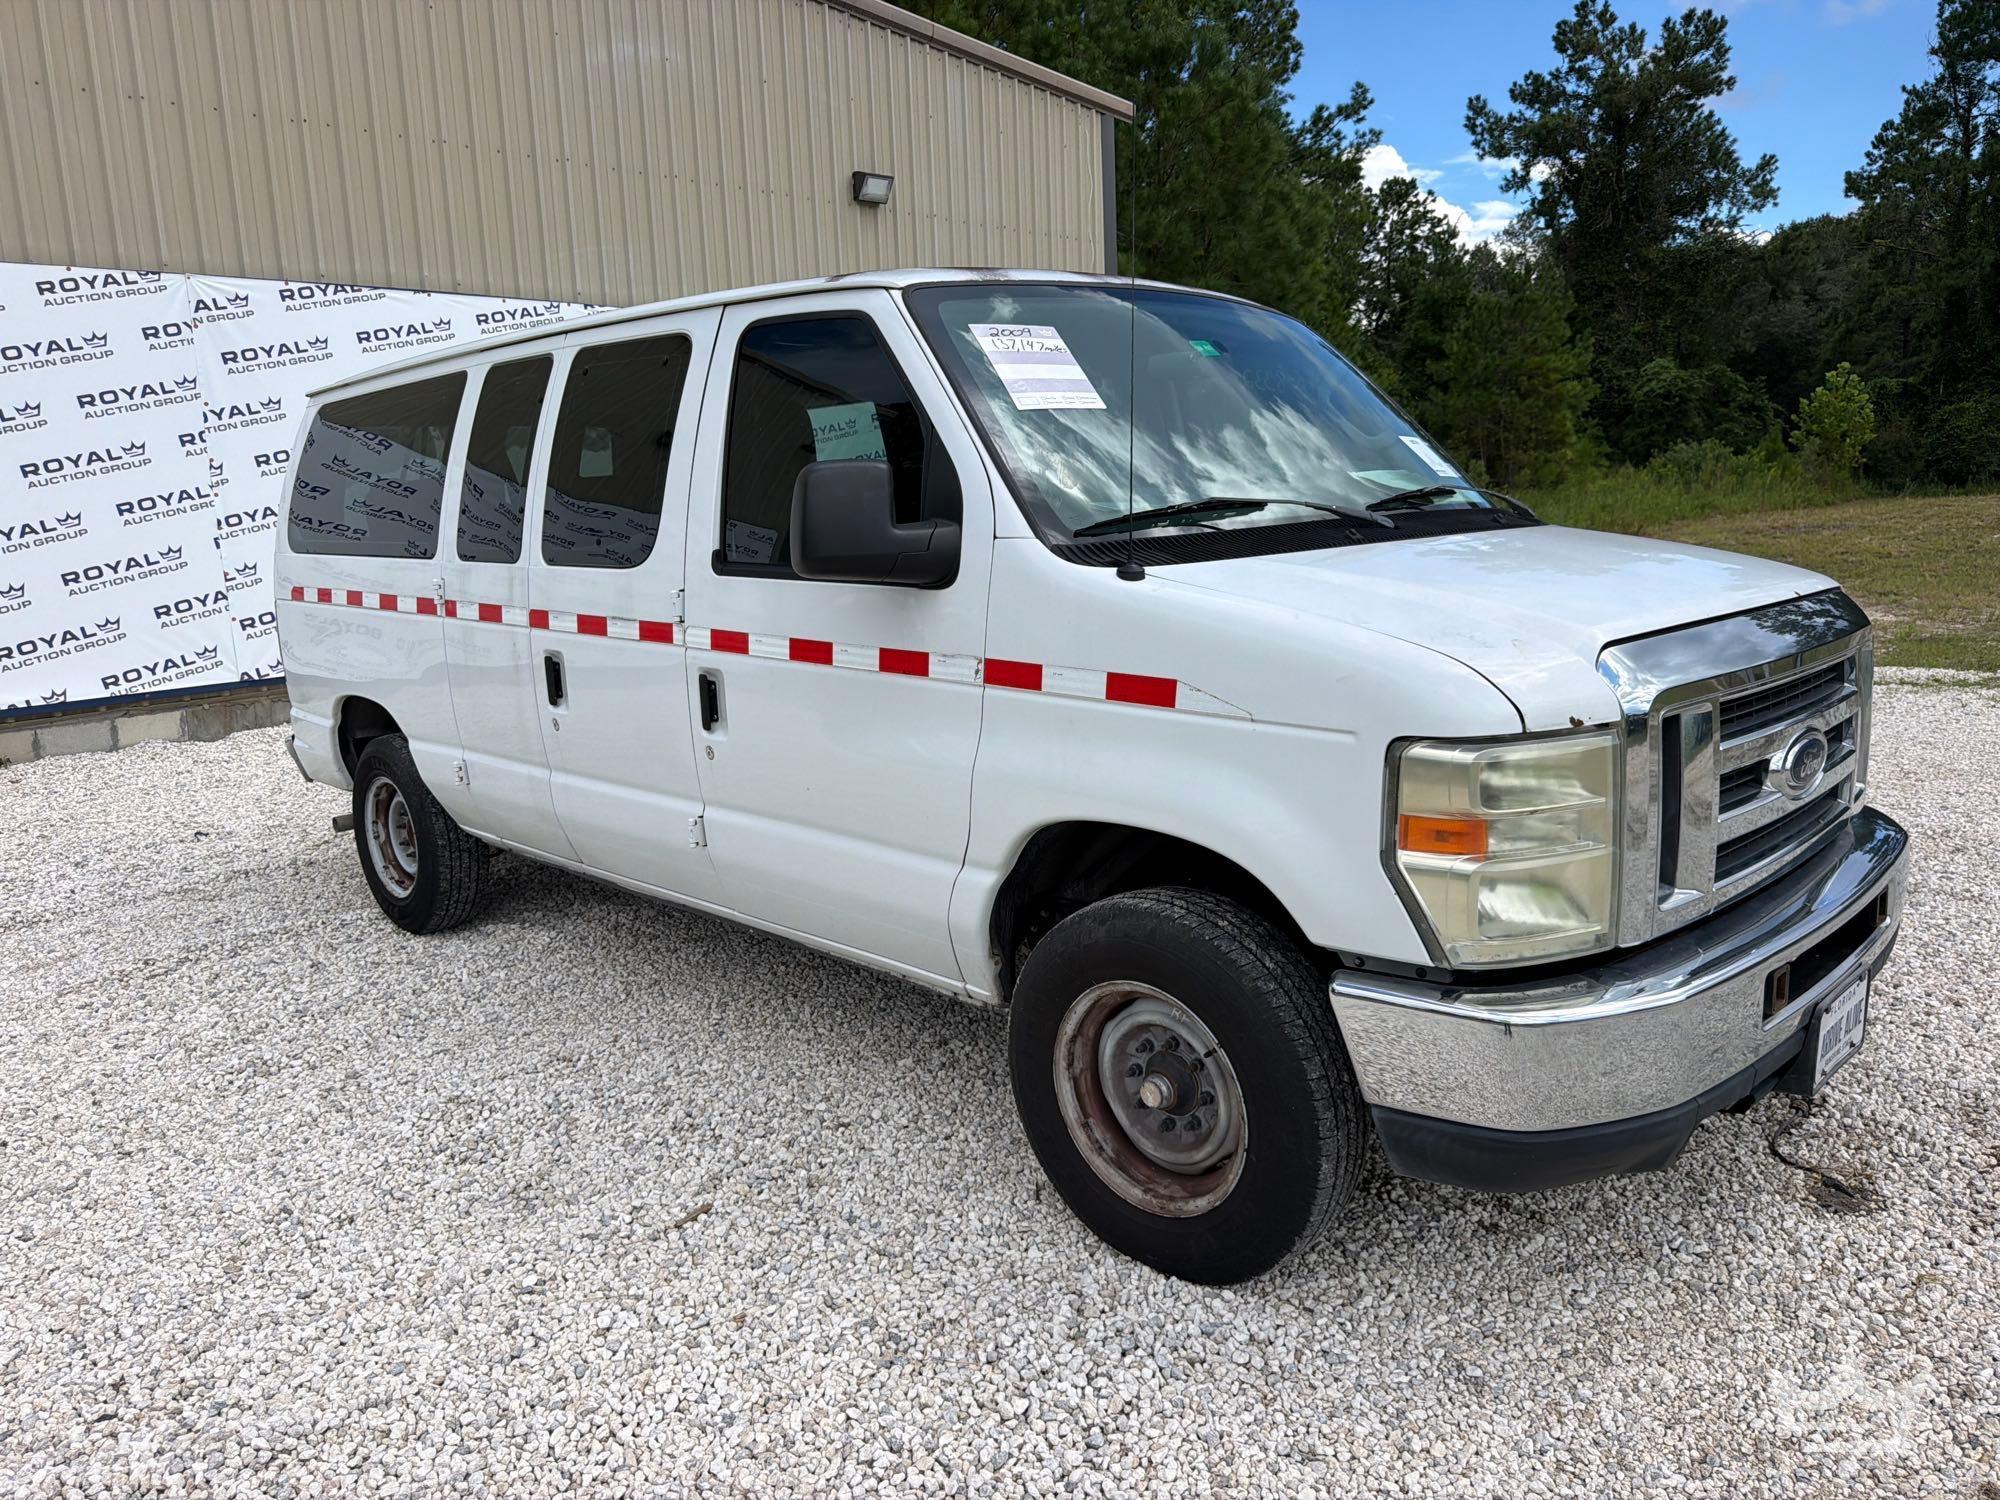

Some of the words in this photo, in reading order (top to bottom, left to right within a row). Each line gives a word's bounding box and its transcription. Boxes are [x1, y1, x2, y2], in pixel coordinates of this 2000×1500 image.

[35, 271, 139, 296] ROYAL
[44, 291, 113, 307] AUCTION
[116, 285, 168, 298] GROUP
[285, 299, 342, 312] AUCTION
[344, 293, 386, 304] GROUP
[206, 310, 255, 323] GROUP
[475, 305, 545, 326] ROYAL
[141, 320, 193, 341] ROY
[356, 322, 433, 344] ROYAL
[480, 322, 528, 336] AUCTION
[989, 327, 1032, 338] 2009
[0, 337, 84, 361] OYAL
[149, 338, 195, 351] AUCTI
[220, 341, 309, 365] ROYAL
[361, 339, 414, 354] AUCTION
[416, 333, 456, 347] GROUP
[0, 358, 57, 374] UCTION
[60, 350, 114, 365] GROUP
[227, 359, 287, 375] AUCTION
[288, 352, 333, 365] GROUP
[76, 381, 175, 409] ROYAL
[84, 401, 151, 420] AUCTION
[153, 392, 202, 408] GROUP
[203, 403, 261, 424] YAL
[205, 422, 238, 434] TION
[240, 413, 287, 428] GROUP
[0, 419, 48, 435] ROUP
[19, 448, 123, 479] ROYAL
[27, 468, 97, 489] AUCTION
[99, 458, 152, 475] GROUP
[116, 486, 211, 517] ROYAL
[122, 506, 188, 527] AUCTION
[0, 520, 58, 541] YAL
[33, 528, 88, 547] GROUP
[219, 523, 271, 540] UCTION
[61, 553, 160, 587] ROYAL
[69, 575, 136, 597] AUCTION
[138, 561, 188, 579] GROUP
[226, 577, 263, 592] ROUP
[0, 600, 32, 614] OUP
[153, 590, 228, 620] ROYA
[160, 607, 221, 629] AUCTION
[0, 626, 98, 660] ROYAL
[246, 626, 277, 641] AUCT
[1, 648, 72, 673] AUCTION
[74, 632, 127, 653] GROUP
[101, 655, 196, 690] ROYAL
[110, 676, 172, 698] AUCTION
[175, 660, 224, 680] GROUP
